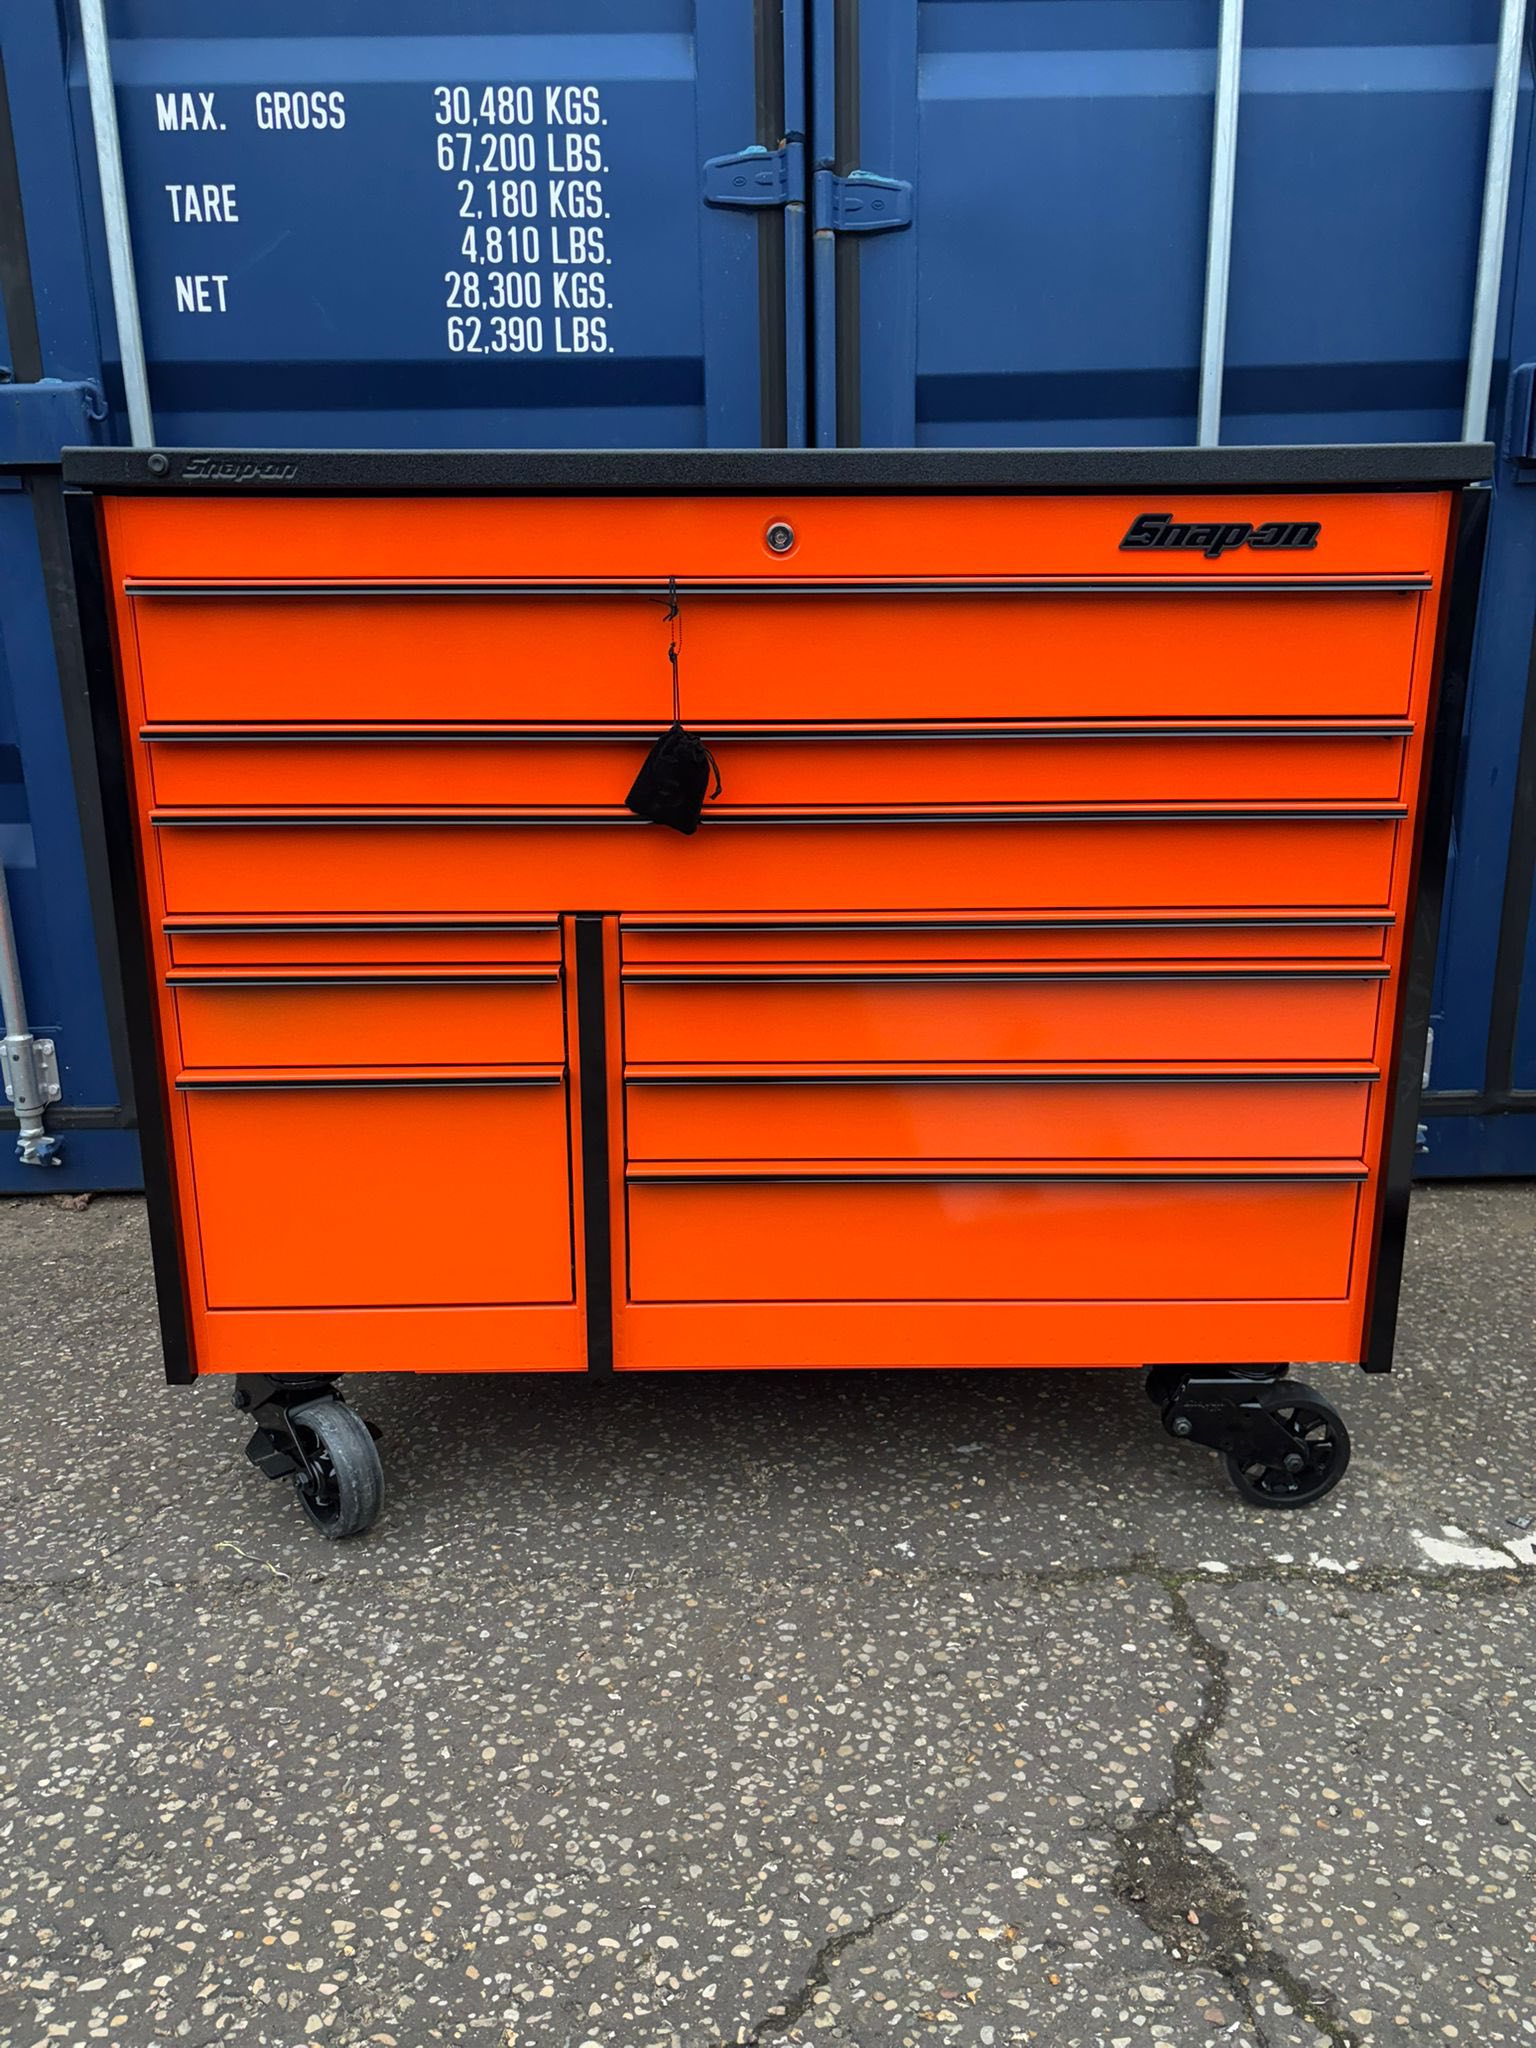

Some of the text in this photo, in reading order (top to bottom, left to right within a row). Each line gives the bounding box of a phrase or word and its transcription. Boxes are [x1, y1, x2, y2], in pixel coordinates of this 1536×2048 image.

[155, 86, 608, 131] MAX. GROSS 30,480 KGS.
[437, 133, 609, 174] 67,200 LBS.
[165, 180, 610, 223] TARE 2,180 KGS.
[461, 226, 612, 265] 4,810 LBS.
[175, 271, 613, 313] NET 28,300 KGS.
[447, 316, 614, 354] 62,390 LBS.
[1119, 513, 1322, 558] Snap-on
